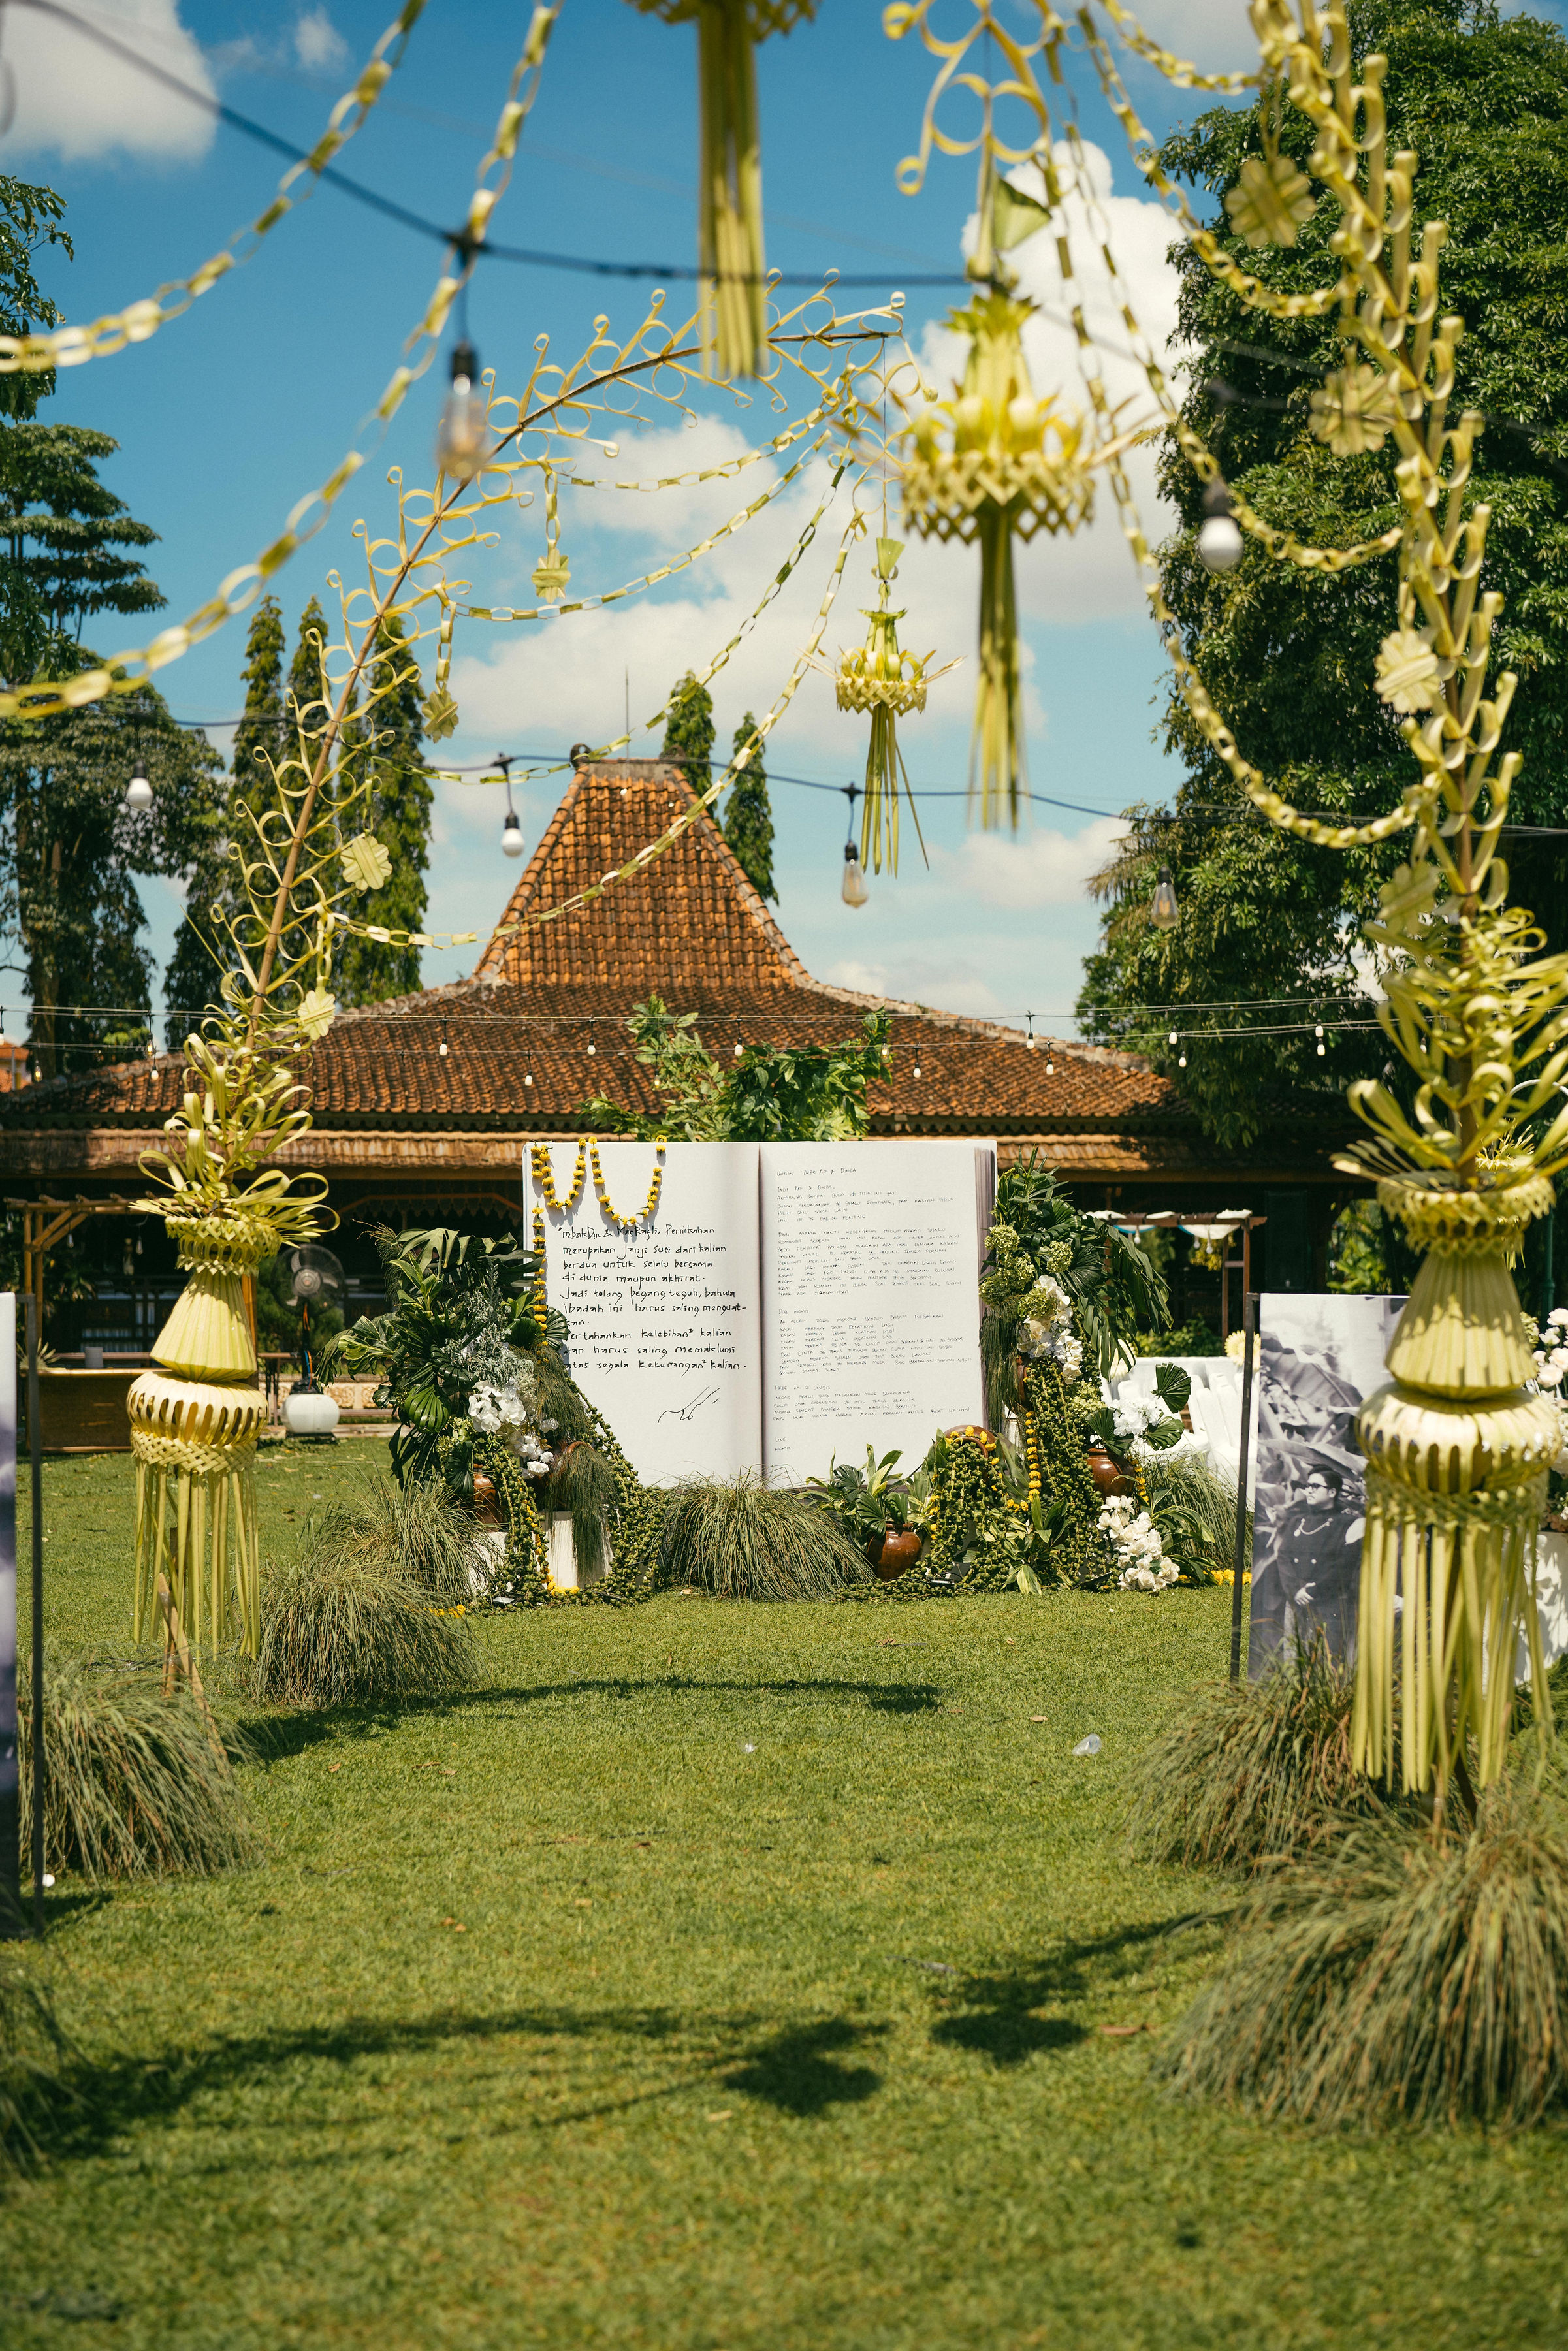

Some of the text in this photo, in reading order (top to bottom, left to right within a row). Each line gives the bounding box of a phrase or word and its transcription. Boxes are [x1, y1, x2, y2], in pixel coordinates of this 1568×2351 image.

[665, 1224, 714, 1237] Pernikahan
[563, 1245, 615, 1260] merupakan
[563, 1260, 596, 1270] berdua
[603, 1260, 635, 1268] untuk
[675, 1259, 712, 1268] bersama
[562, 1271, 577, 1282] di
[672, 1303, 699, 1317] saling
[594, 1345, 628, 1354] harus
[637, 1346, 667, 1359] saling
[596, 1360, 628, 1375] segala
